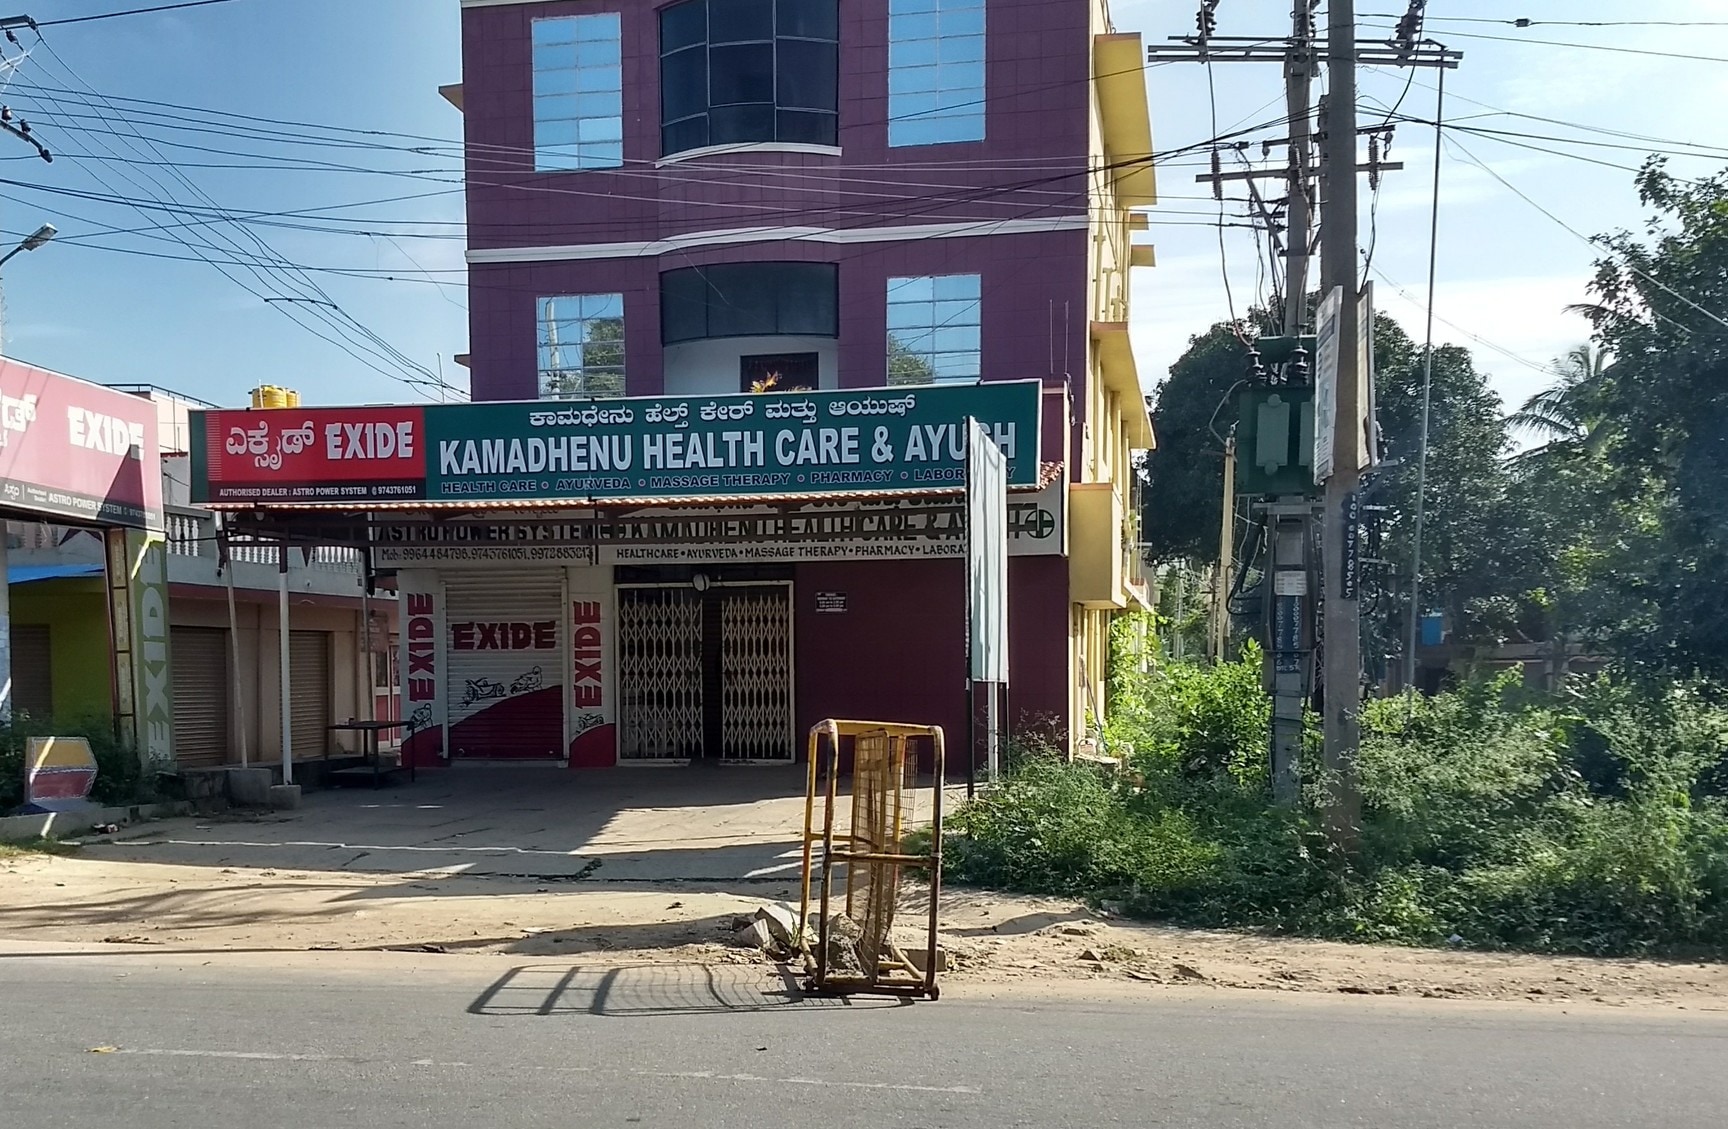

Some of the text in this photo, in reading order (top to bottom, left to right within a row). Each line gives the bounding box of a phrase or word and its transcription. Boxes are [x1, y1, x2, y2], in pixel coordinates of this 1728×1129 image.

[529, 393, 916, 429] ಕಾಮಧೇನು ಹೆಲ್ತ್ ಕೇರ್ ಮತ್ತು ಆಯುಷ್
[67, 405, 145, 461] EXIDE
[325, 421, 414, 460] EXIDE
[439, 421, 1016, 476] KAMADHENU HEALTH CARE & AYUH
[219, 486, 261, 497] AUTHORISED
[262, 487, 288, 497] DEALER
[292, 487, 315, 496] ASTRO
[316, 486, 340, 496] POWER
[340, 486, 367, 495] SYSTEM
[441, 465, 1016, 494] HEALTH CARE AYURVEDA MASSAGE THERAPY PHARMACY LABORY
[48, 492, 72, 507] ASTRO
[73, 497, 97, 511] POWER
[97, 501, 122, 516] SYSTEM
[616, 548, 679, 560] HEALTHCARE
[687, 548, 738, 559] AYURVEDA
[744, 547, 795, 558] MASSAGE
[797, 545, 848, 557] THERAPY
[855, 545, 916, 556] PHARMACY
[138, 545, 172, 760] EXIDE
[407, 592, 436, 703] EXIDE
[451, 620, 557, 650] EXIDE
[572, 600, 603, 710] EXIDE
